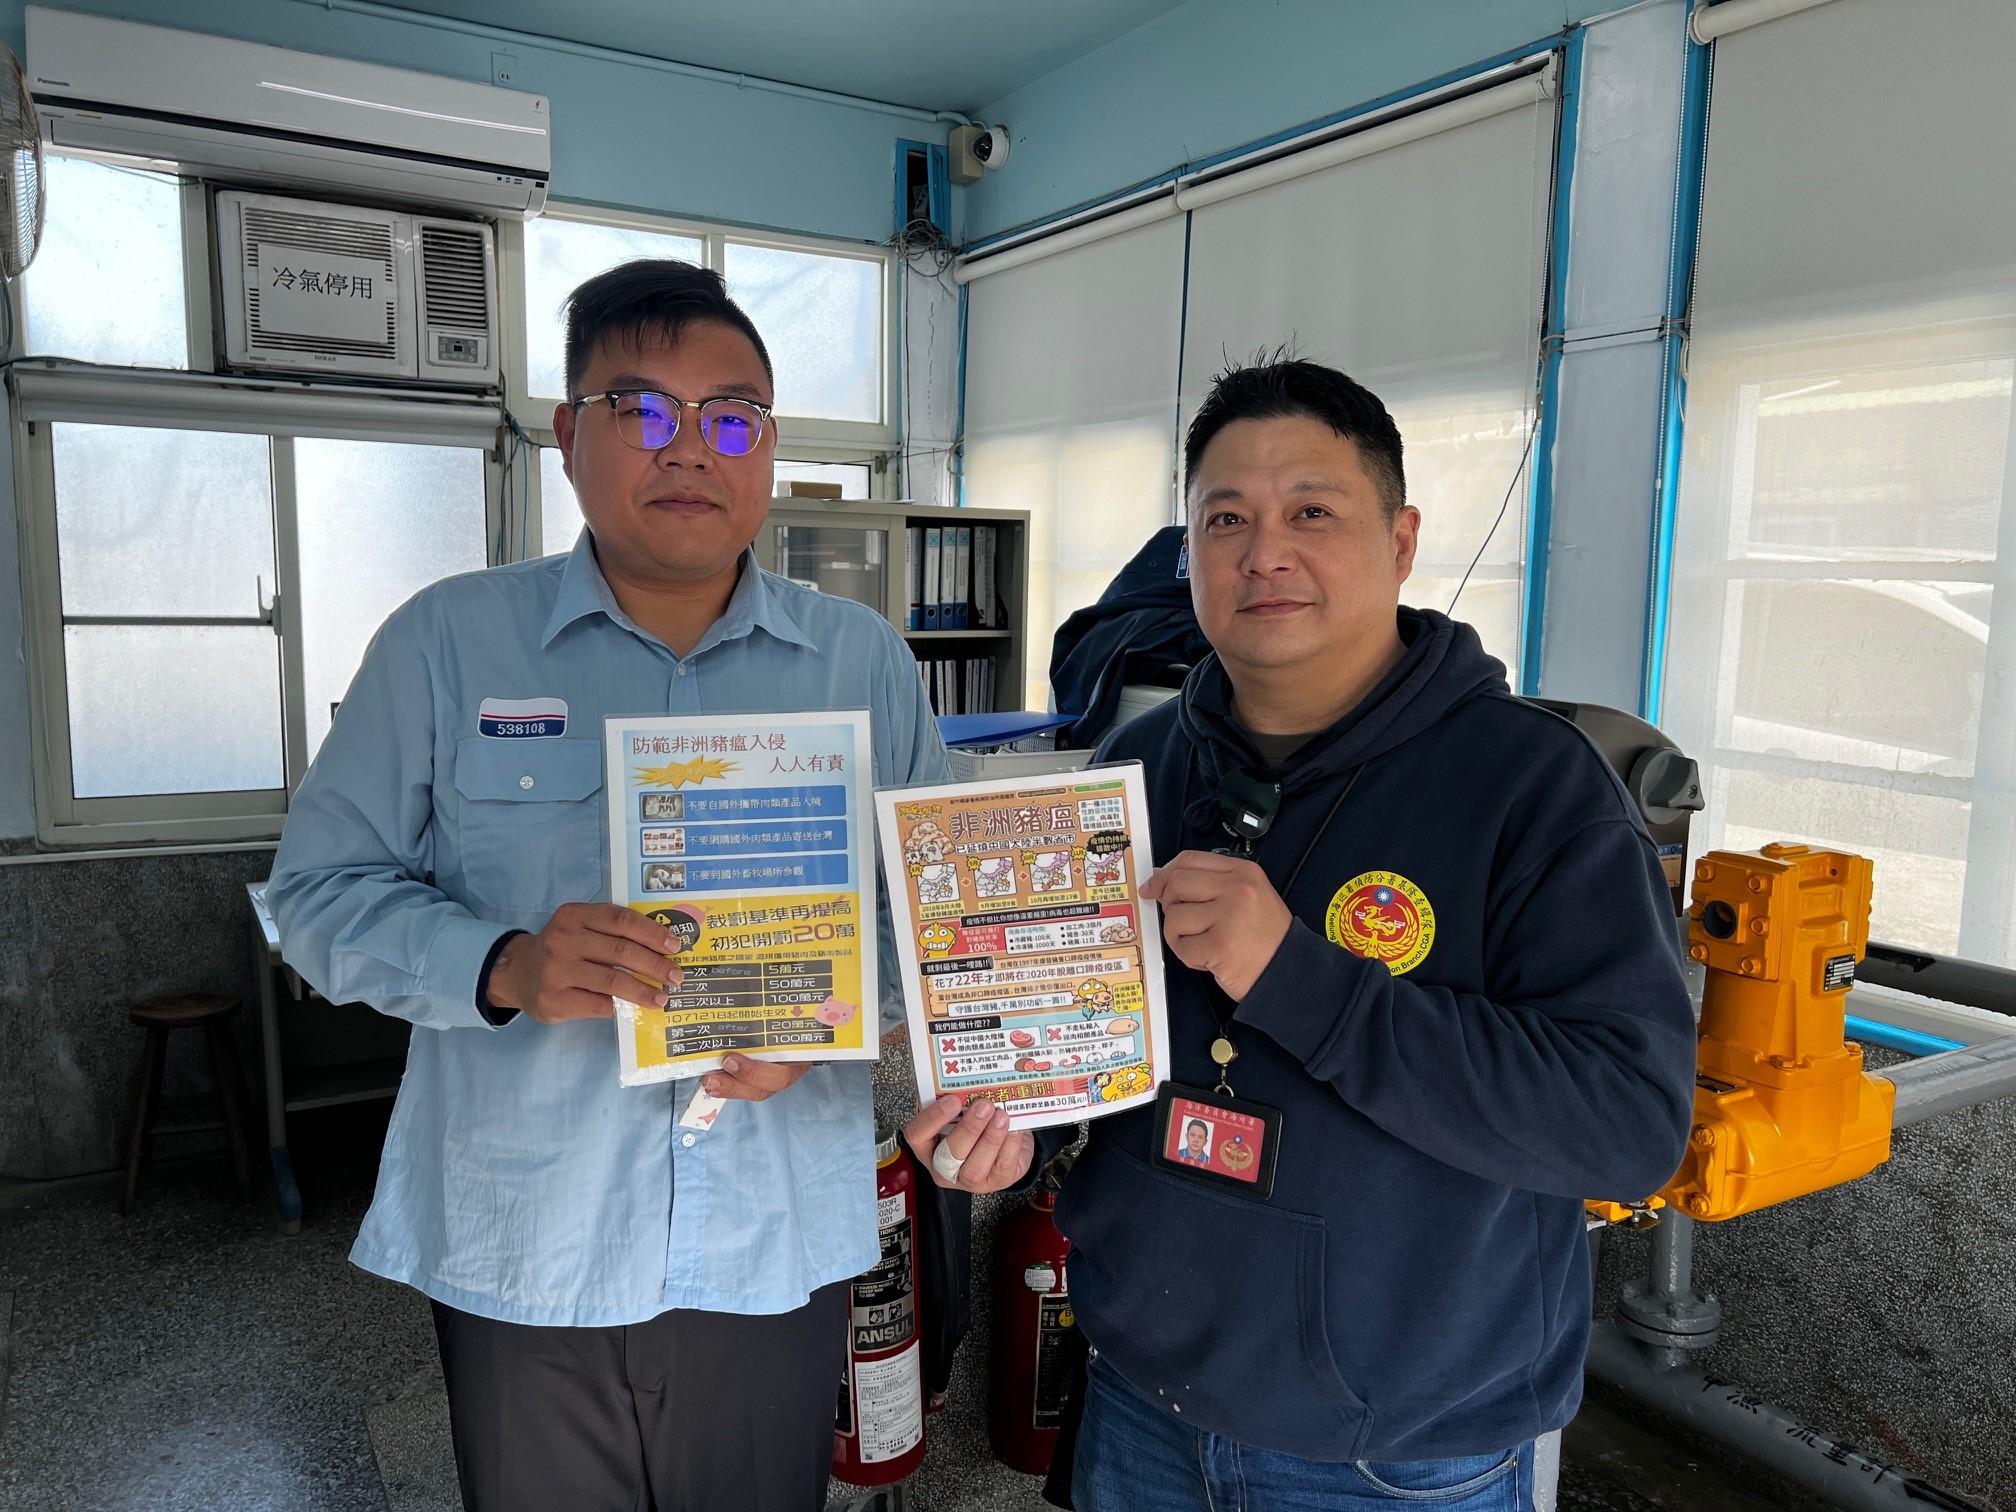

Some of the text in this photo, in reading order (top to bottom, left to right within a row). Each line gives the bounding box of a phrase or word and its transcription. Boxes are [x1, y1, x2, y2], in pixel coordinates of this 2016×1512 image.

[38, 77, 70, 87] Panasonic
[272, 266, 373, 299] 冷氣停用
[497, 722, 546, 735] 538108
[633, 733, 786, 755] 防範非洲豬瘟入侵
[769, 754, 844, 773] 人人有責
[950, 802, 1076, 840] 非洲豬瘟
[956, 833, 1076, 854] 已延燒中國大陸半數省市
[706, 900, 851, 930] 裁罰基準再提高
[710, 922, 855, 952] 初犯開罰20萬
[968, 941, 998, 953] 100%
[684, 966, 751, 978] 一次 before
[769, 963, 805, 974] 5萬元
[668, 981, 708, 993] 第二次
[769, 978, 815, 989] 50萬元
[669, 997, 735, 1009] 第三次以上
[770, 992, 824, 1004] 100萬元
[665, 1008, 787, 1024] 1071218起開始生效
[671, 1023, 750, 1038] 第一次 after
[771, 1019, 818, 1030] 20萬元
[934, 1018, 991, 1032] 我們能做什麼??
[772, 1033, 826, 1044] 100萬元
[672, 1038, 737, 1054] 第二次以上
[857, 1318, 912, 1344] ANSUL
